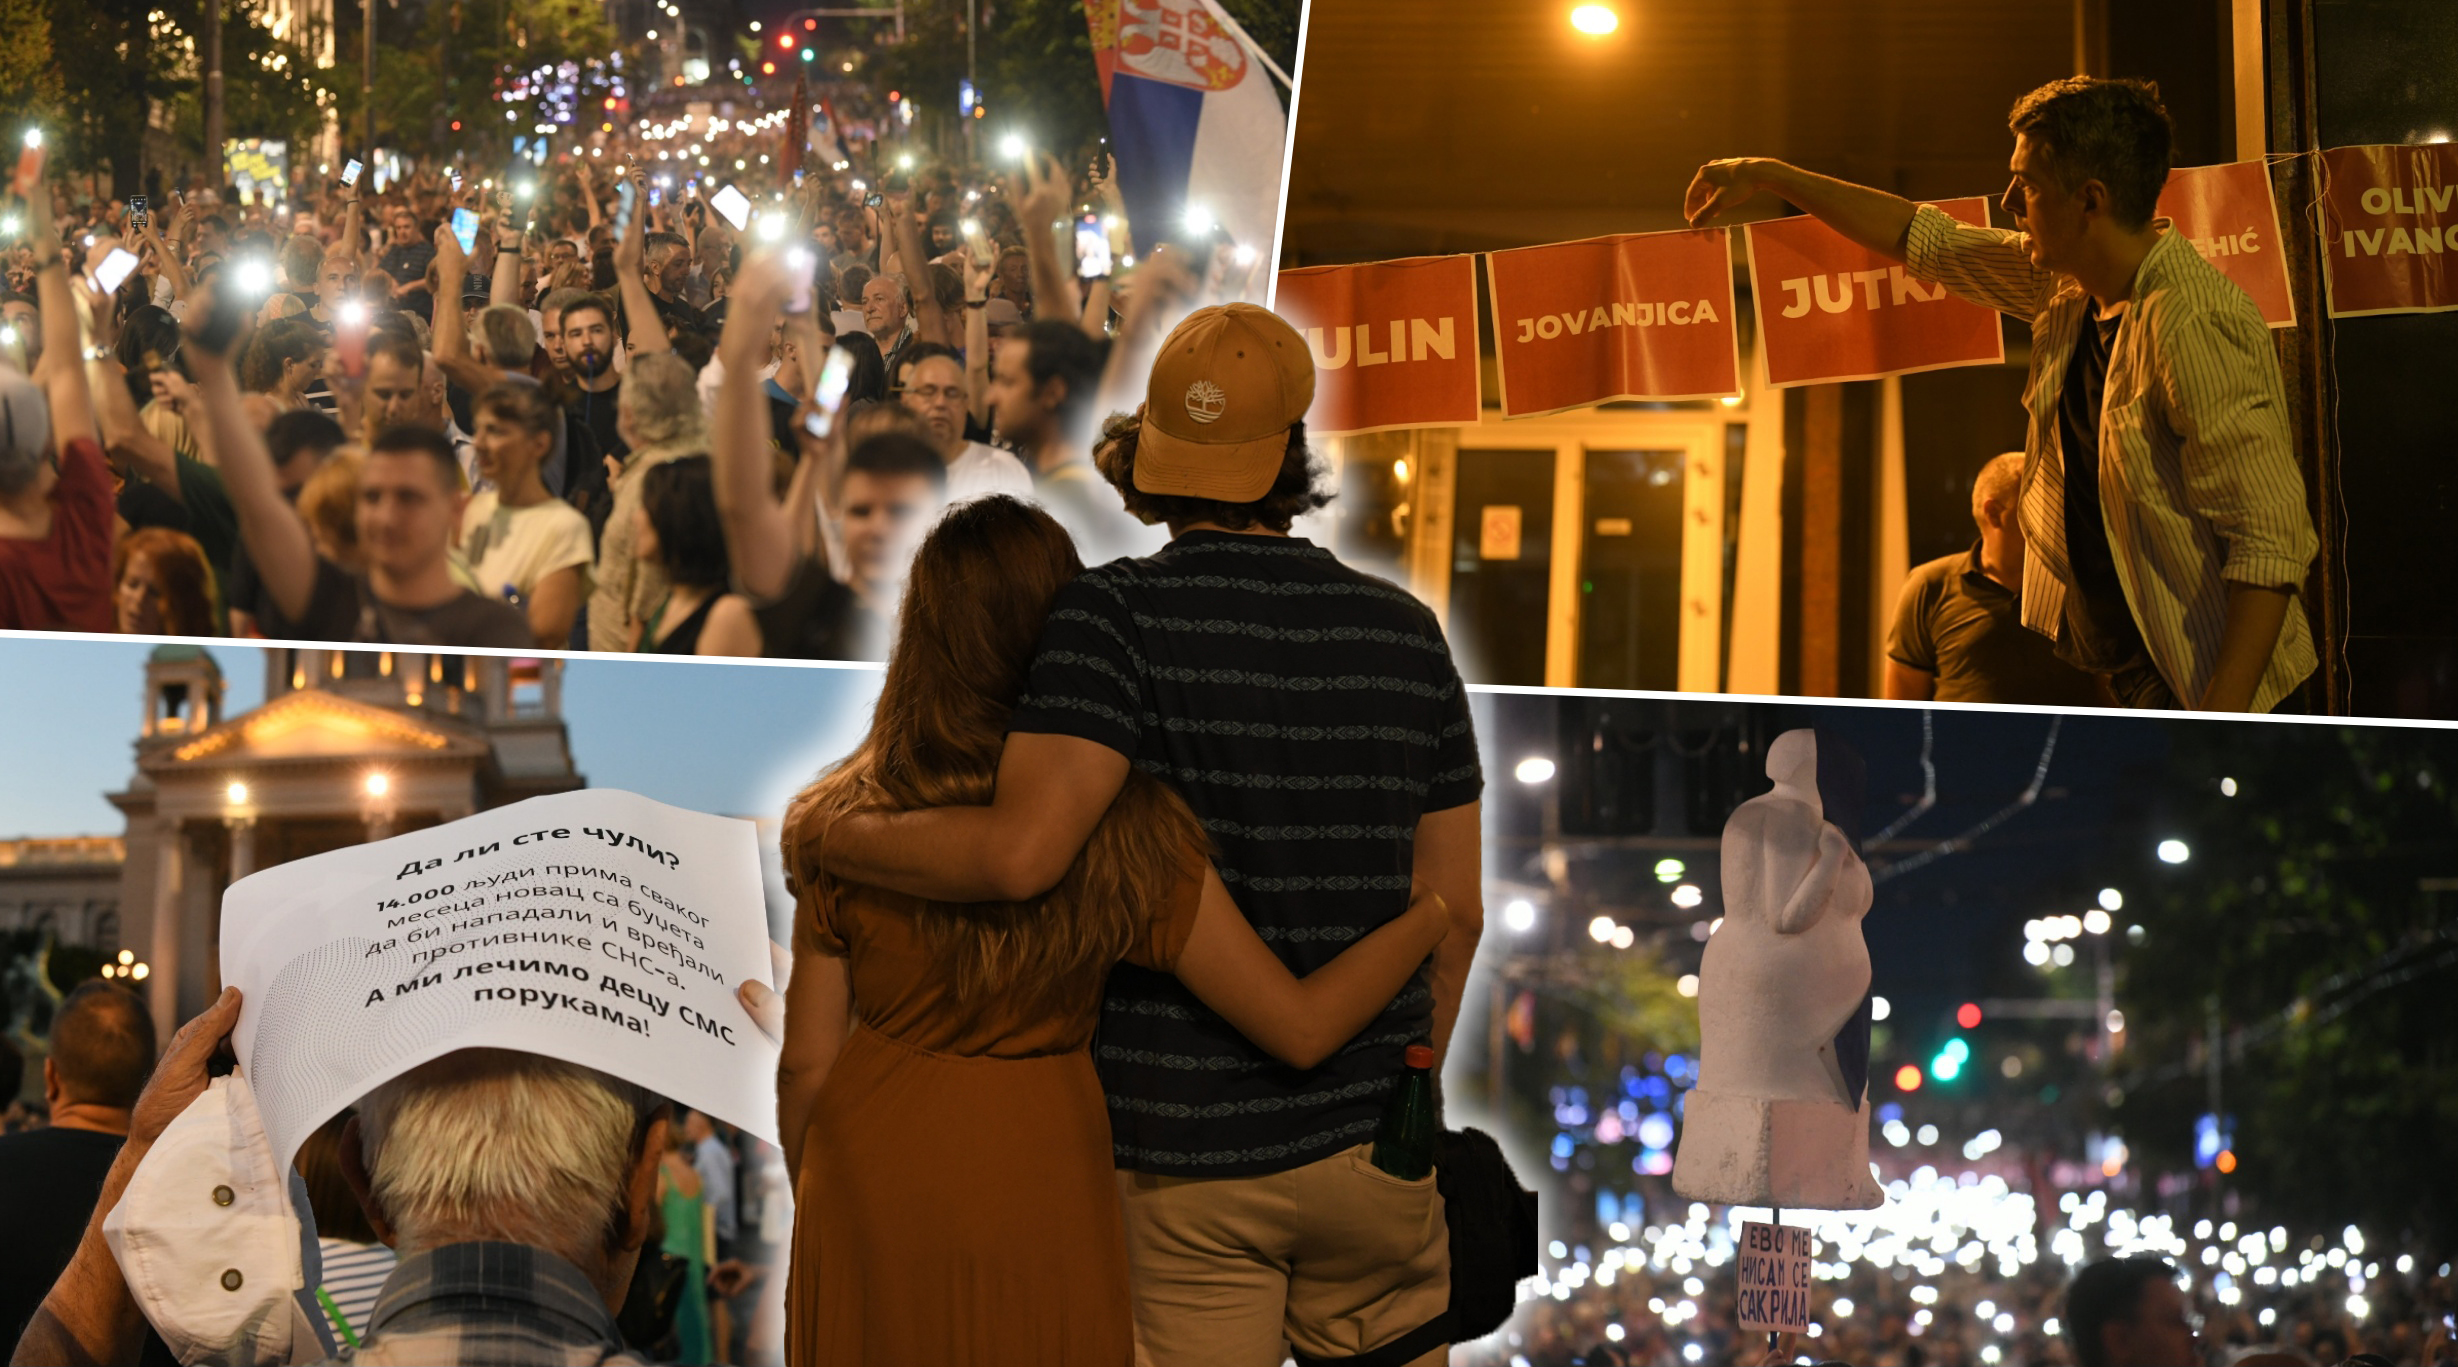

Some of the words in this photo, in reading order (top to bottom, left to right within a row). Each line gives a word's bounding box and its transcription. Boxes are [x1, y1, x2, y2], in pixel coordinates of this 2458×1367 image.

[2360, 184, 2458, 216] OLIV
[2188, 226, 2261, 259] EHIĆ
[1781, 265, 1947, 319] JUTK
[1297, 316, 1456, 370] ULIN
[1516, 299, 1719, 344] JOVANJICA
[396, 858, 442, 880] Да
[454, 842, 500, 863] ли
[513, 828, 571, 846] сте
[583, 827, 680, 871] чули?
[377, 884, 456, 912] 14.000
[464, 867, 535, 891] људи
[545, 864, 632, 888] прима
[640, 884, 709, 928] сваког
[387, 897, 485, 929] месеца
[496, 886, 584, 902] новац
[593, 890, 619, 908] са
[628, 900, 704, 950] буџета
[365, 938, 396, 958] да
[407, 926, 440, 943] би
[452, 908, 592, 931] нападали
[603, 917, 617, 932] и
[628, 926, 724, 985] вређали
[413, 931, 592, 964] противнике
[602, 942, 685, 990] СНС-а.
[366, 988, 385, 1007] А
[396, 972, 442, 996] ми
[454, 960, 589, 981] лечимо
[600, 975, 670, 1017] децу
[679, 1005, 735, 1046] СМС
[474, 987, 650, 1037] порукама!
[1749, 1226, 1784, 1252] ЕВО
[1792, 1229, 1809, 1257] МЕ
[1741, 1256, 1785, 1286] НИСАМ
[1792, 1261, 1808, 1288] СЕ
[1739, 1290, 1807, 1327] САКРИЛА
